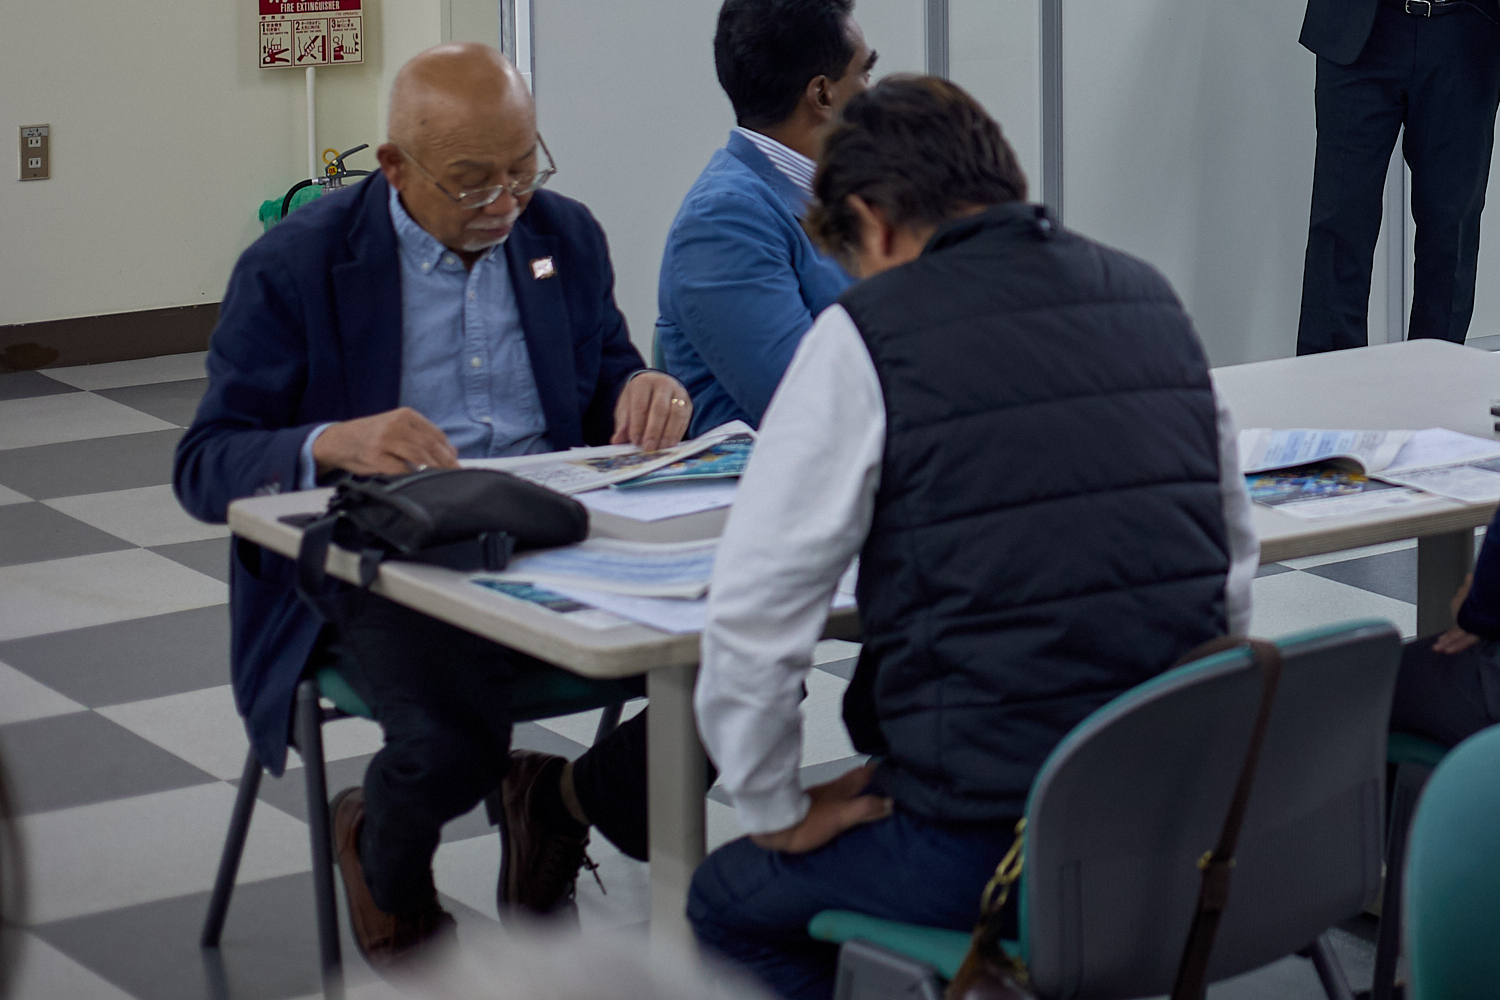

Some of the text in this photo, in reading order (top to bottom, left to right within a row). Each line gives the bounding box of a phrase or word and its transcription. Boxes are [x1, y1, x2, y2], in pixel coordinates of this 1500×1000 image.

[281, 1, 340, 12] FIRE EXTINGUISHER
[295, 21, 300, 31] 2
[331, 19, 336, 28] 3
